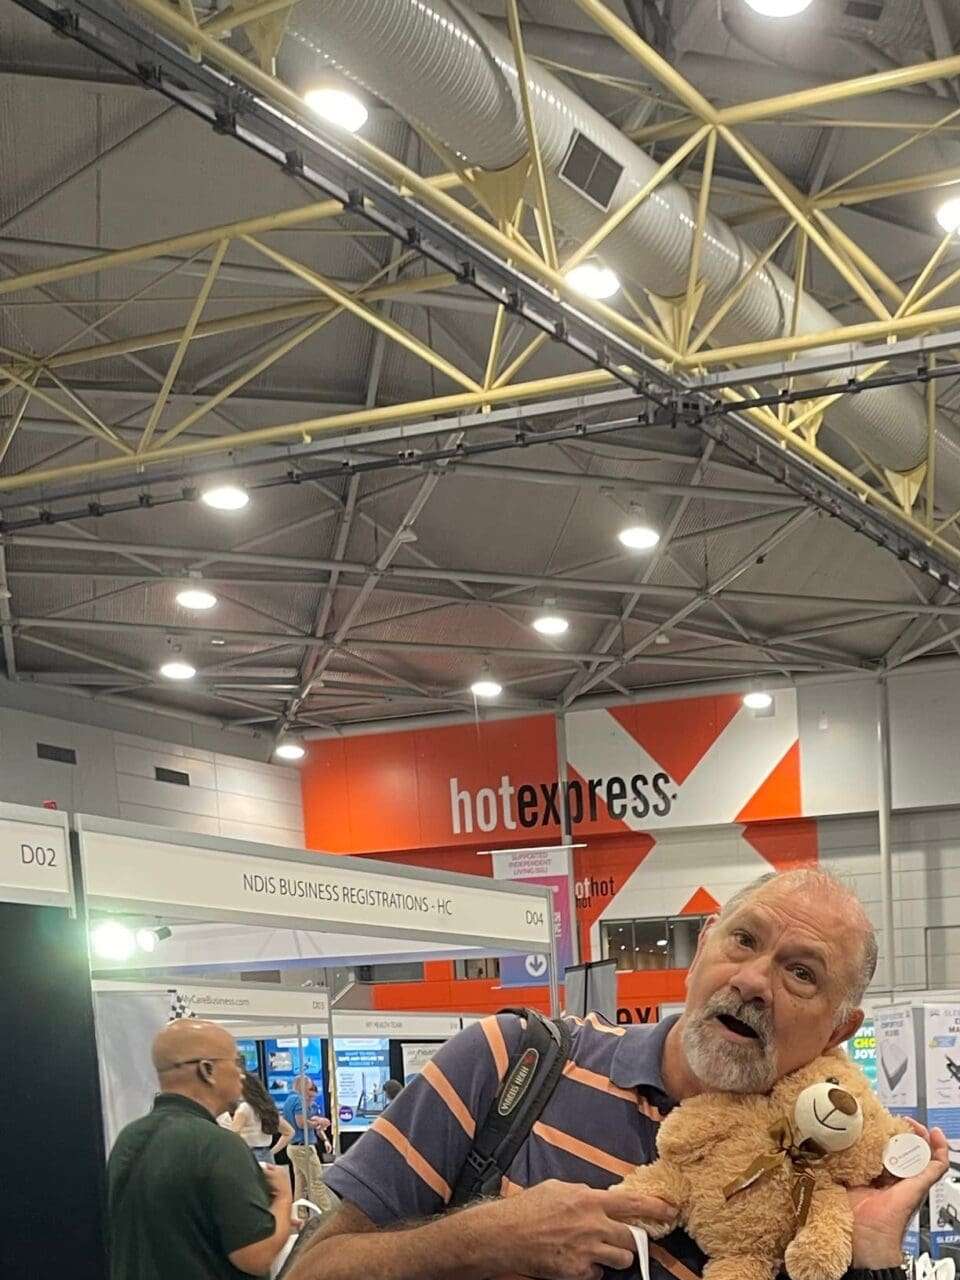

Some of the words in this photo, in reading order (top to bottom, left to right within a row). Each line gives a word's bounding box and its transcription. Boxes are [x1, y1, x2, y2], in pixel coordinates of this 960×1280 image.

[450, 772, 672, 835] hotexpress
[20, 844, 57, 868] D02
[243, 873, 276, 894] NDIS
[279, 879, 340, 902] BUSINESS
[342, 887, 429, 912] REGISTRATIONS
[437, 899, 453, 915] HC
[525, 910, 544, 926] D04
